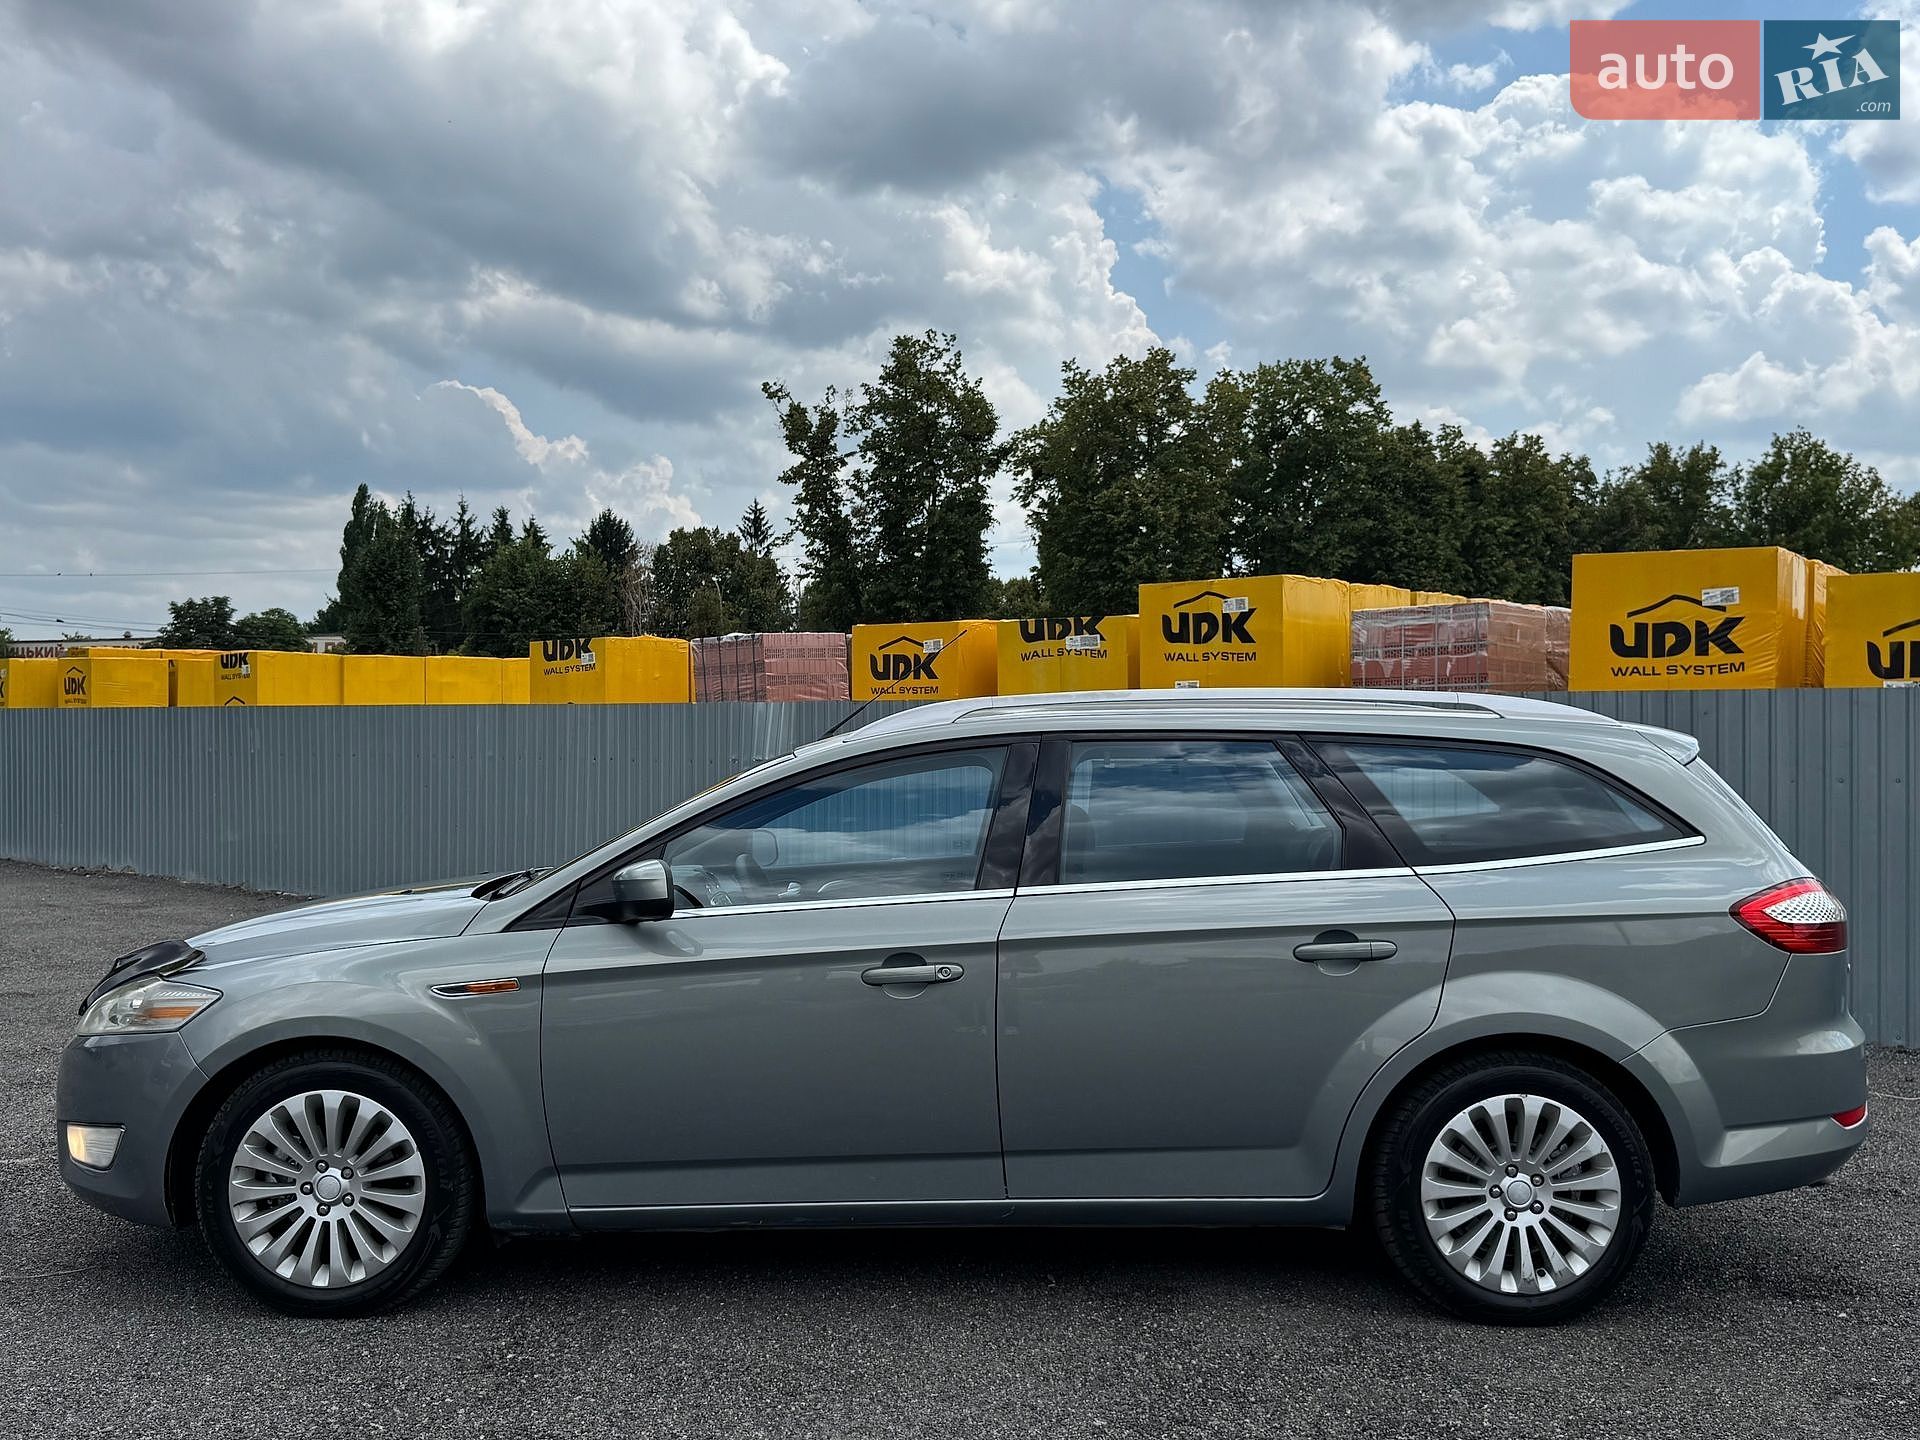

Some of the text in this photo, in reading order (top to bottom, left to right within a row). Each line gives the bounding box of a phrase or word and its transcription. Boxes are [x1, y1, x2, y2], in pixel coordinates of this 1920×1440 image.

[1020, 616, 1106, 643] UDK
[1162, 608, 1257, 644] UDK
[1610, 616, 1745, 658] UDK
[542, 639, 593, 662] UDK
[1021, 647, 1107, 662] WALL SYSTEM
[1164, 651, 1256, 662] WALL SYSTEM
[544, 663, 596, 675] WALL SYSTEM
[870, 654, 939, 680] UDK
[1611, 662, 1745, 677] WALL SYSTEM
[64, 675, 87, 696] UDK
[899, 686, 939, 694] SYSTEM
